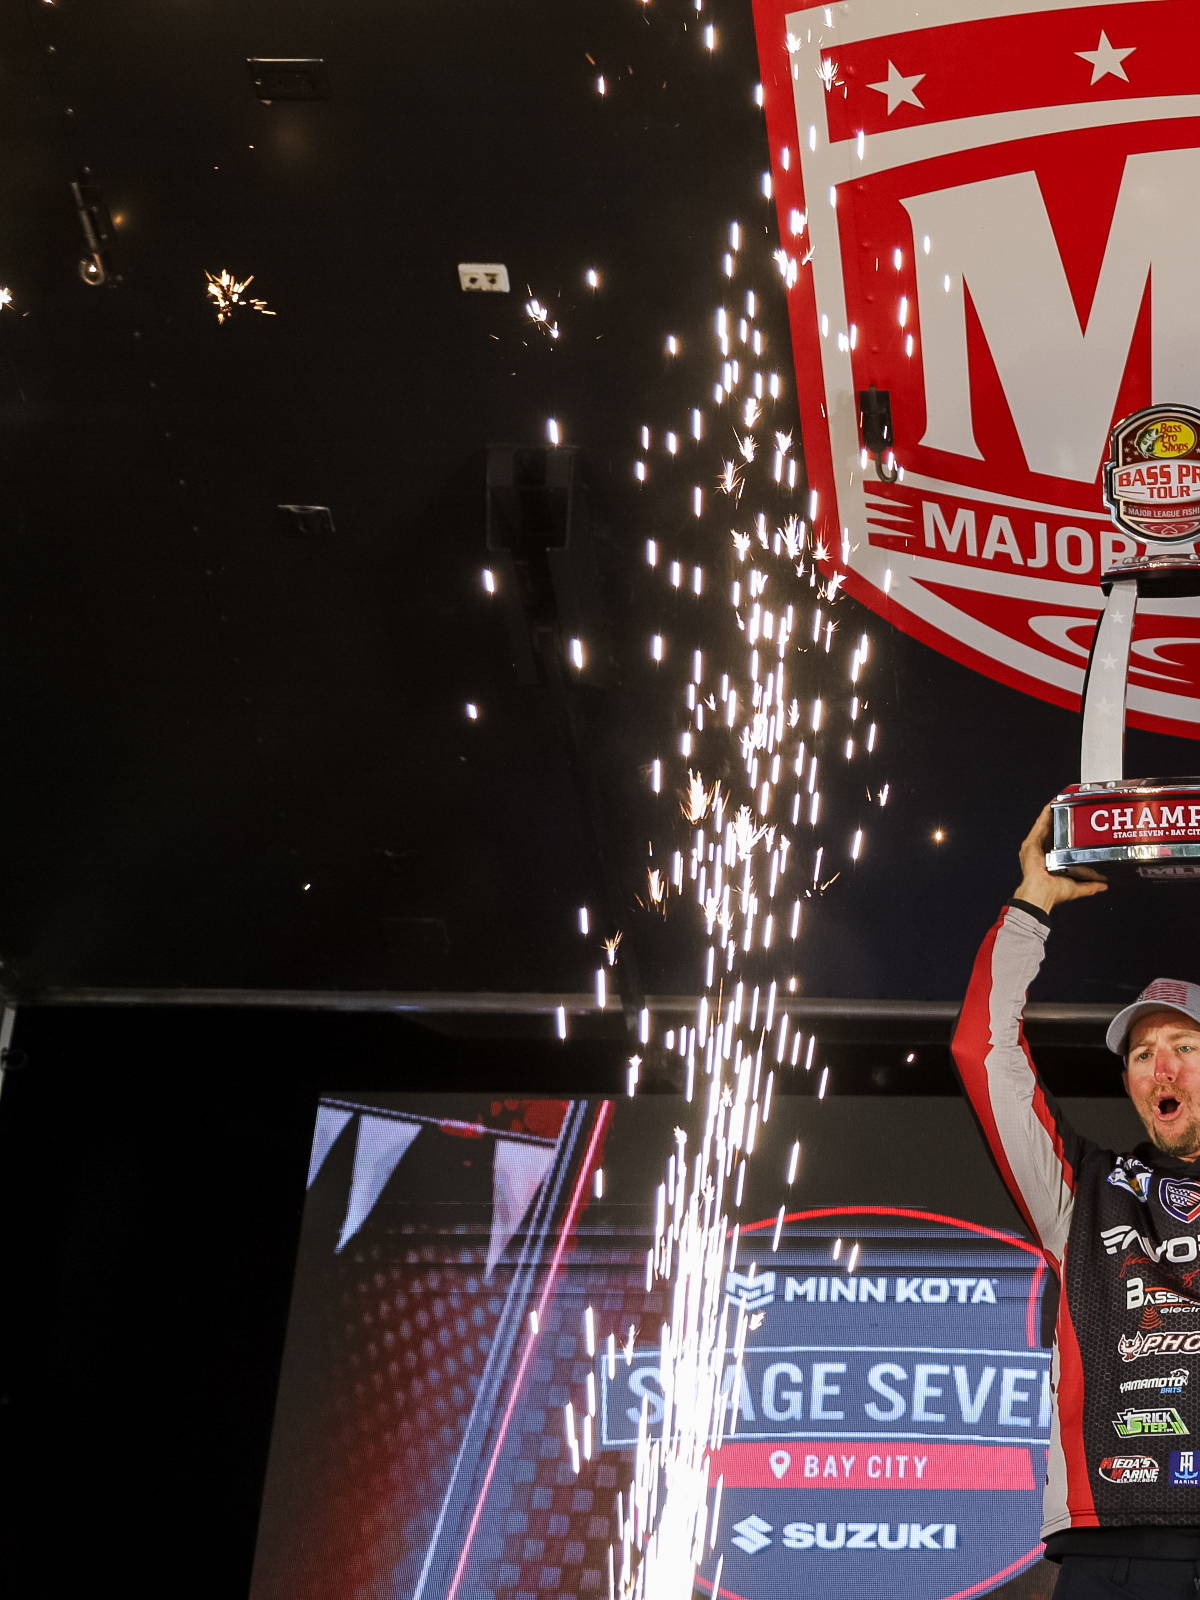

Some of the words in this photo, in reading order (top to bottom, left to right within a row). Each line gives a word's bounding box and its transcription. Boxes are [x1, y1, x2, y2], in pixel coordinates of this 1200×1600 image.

[1160, 422, 1182, 433] Bass
[1161, 432, 1178, 443] Pro
[1161, 441, 1189, 453] Shops
[1118, 463, 1172, 488] BASS
[1146, 485, 1191, 499] TOUR
[1128, 506, 1152, 518] MAJOR
[1153, 507, 1181, 519] LEAGUE
[1113, 830, 1137, 840] STAGE
[1138, 828, 1164, 838] SEVEN
[1170, 828, 1186, 836] BAY
[784, 1276, 887, 1304] MINN
[895, 1276, 998, 1304] KOTA
[1119, 1376, 1188, 1394] YAMAMOTO
[625, 1362, 847, 1424] SAGE
[863, 1362, 1050, 1428] SEVE
[803, 1454, 857, 1480] BAY
[867, 1455, 929, 1480] CITY
[782, 1521, 957, 1551] SUZUKI
